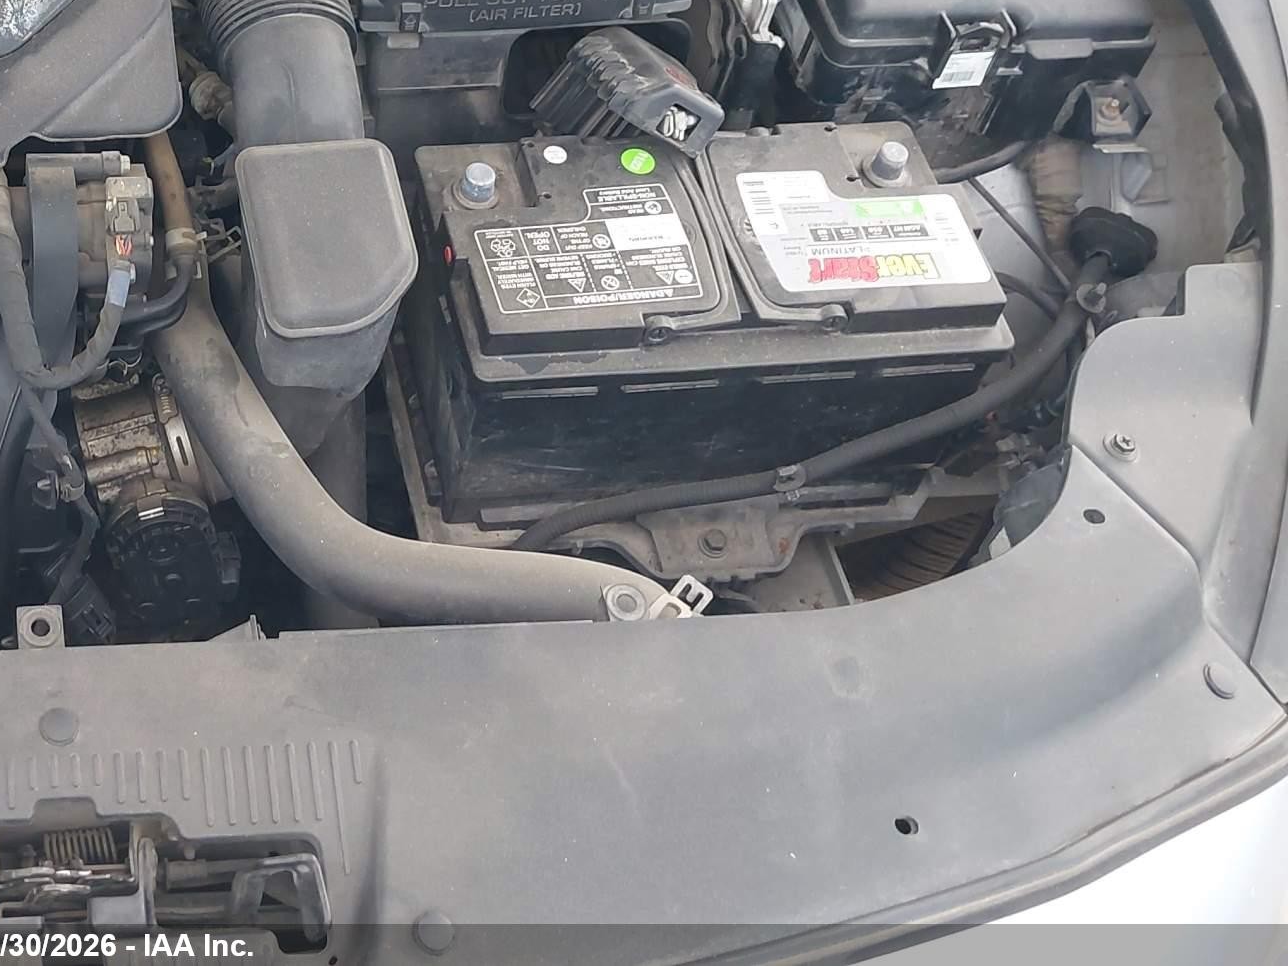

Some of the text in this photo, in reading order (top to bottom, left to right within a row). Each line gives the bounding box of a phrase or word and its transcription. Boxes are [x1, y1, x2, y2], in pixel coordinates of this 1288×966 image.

[469, 2, 582, 23] (AIR FILTER)
[808, 253, 941, 284] EverStart
[573, 290, 665, 305] DANGER/POISON
